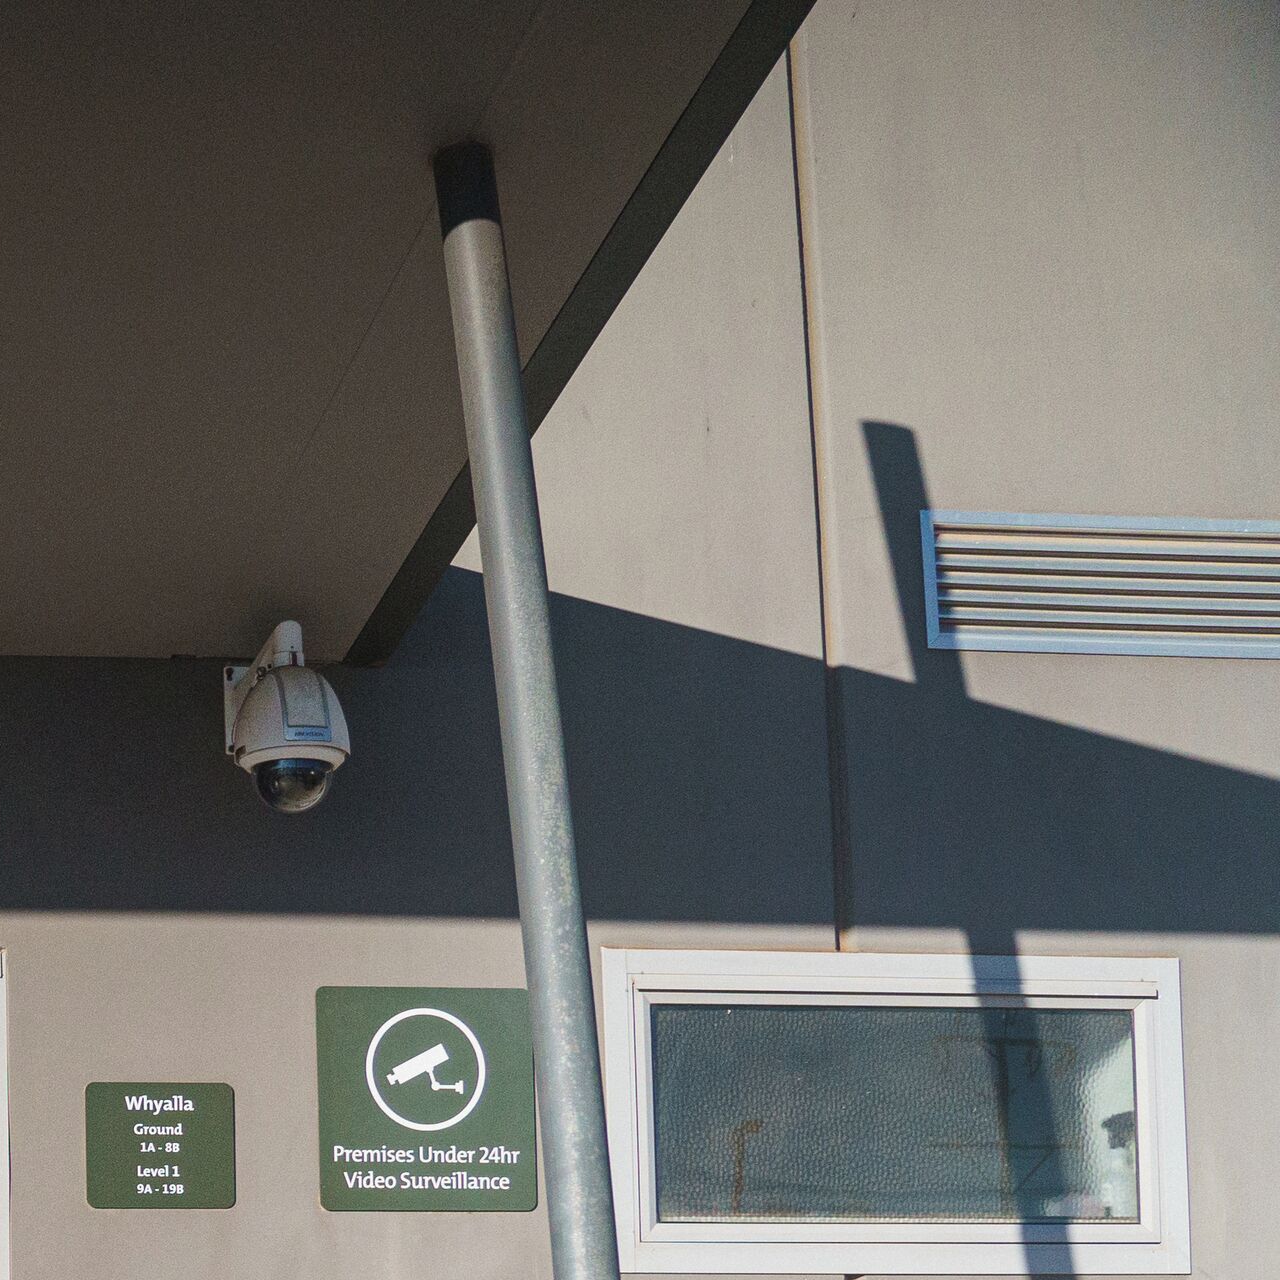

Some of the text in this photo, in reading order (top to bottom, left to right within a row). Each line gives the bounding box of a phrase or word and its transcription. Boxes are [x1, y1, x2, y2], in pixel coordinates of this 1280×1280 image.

[125, 1095, 194, 1115] Whyalla
[134, 1123, 183, 1135] Ground
[140, 1143, 155, 1152] 1A
[165, 1143, 180, 1152] 8B
[333, 1145, 520, 1164] Premises Under 24hr
[138, 1166, 180, 1177] Level 1
[344, 1171, 510, 1190] Video Surveillance
[137, 1184, 152, 1194] 9A
[163, 1184, 184, 1194] 19B
